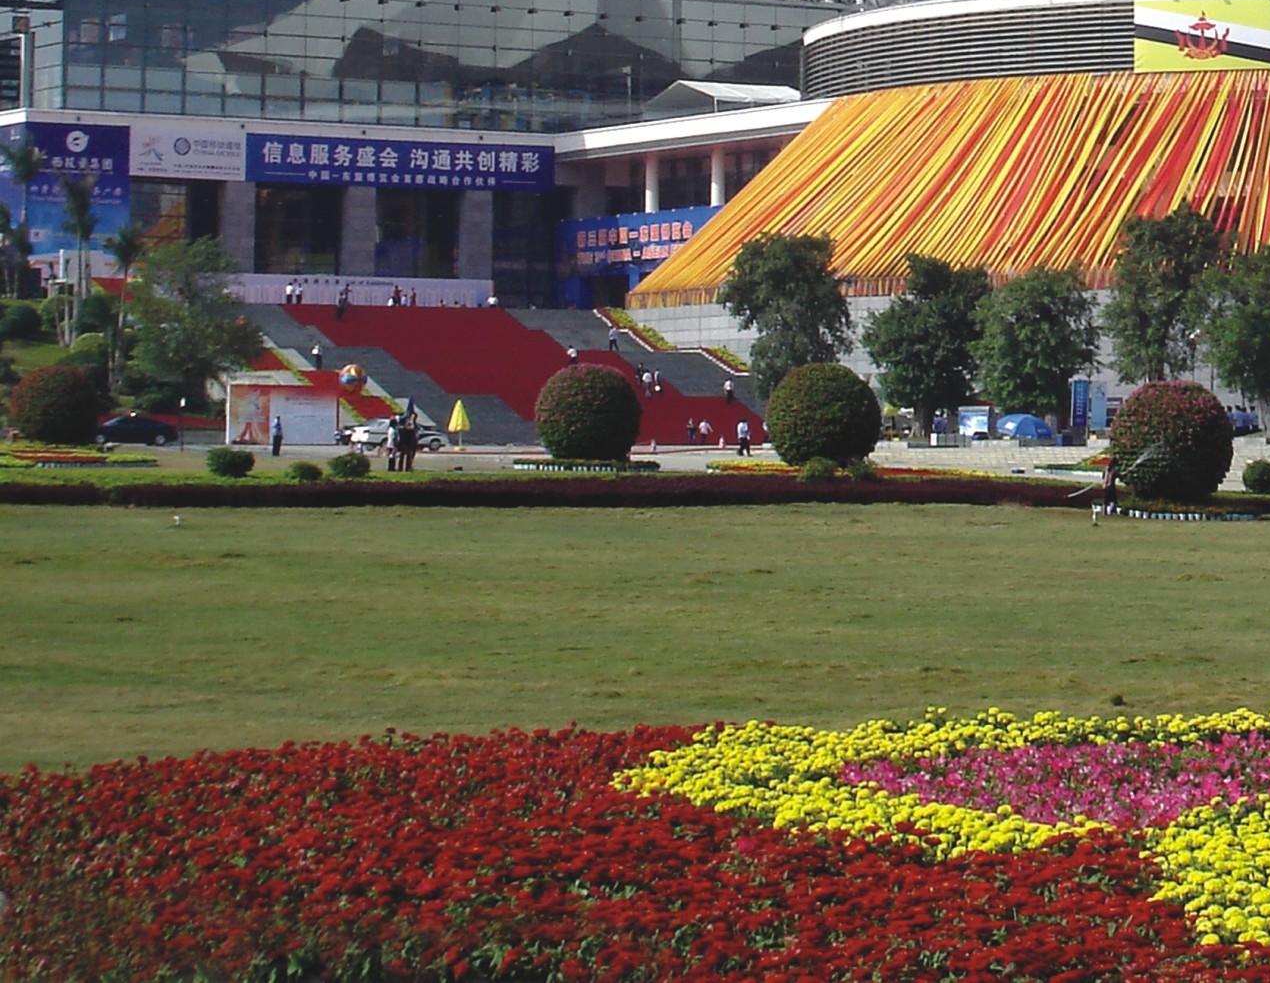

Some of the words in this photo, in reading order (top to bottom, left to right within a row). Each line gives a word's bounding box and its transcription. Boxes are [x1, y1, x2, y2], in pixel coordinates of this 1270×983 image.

[262, 141, 399, 169] 信息服务盛会
[410, 148, 540, 173] 沟通共创精彩
